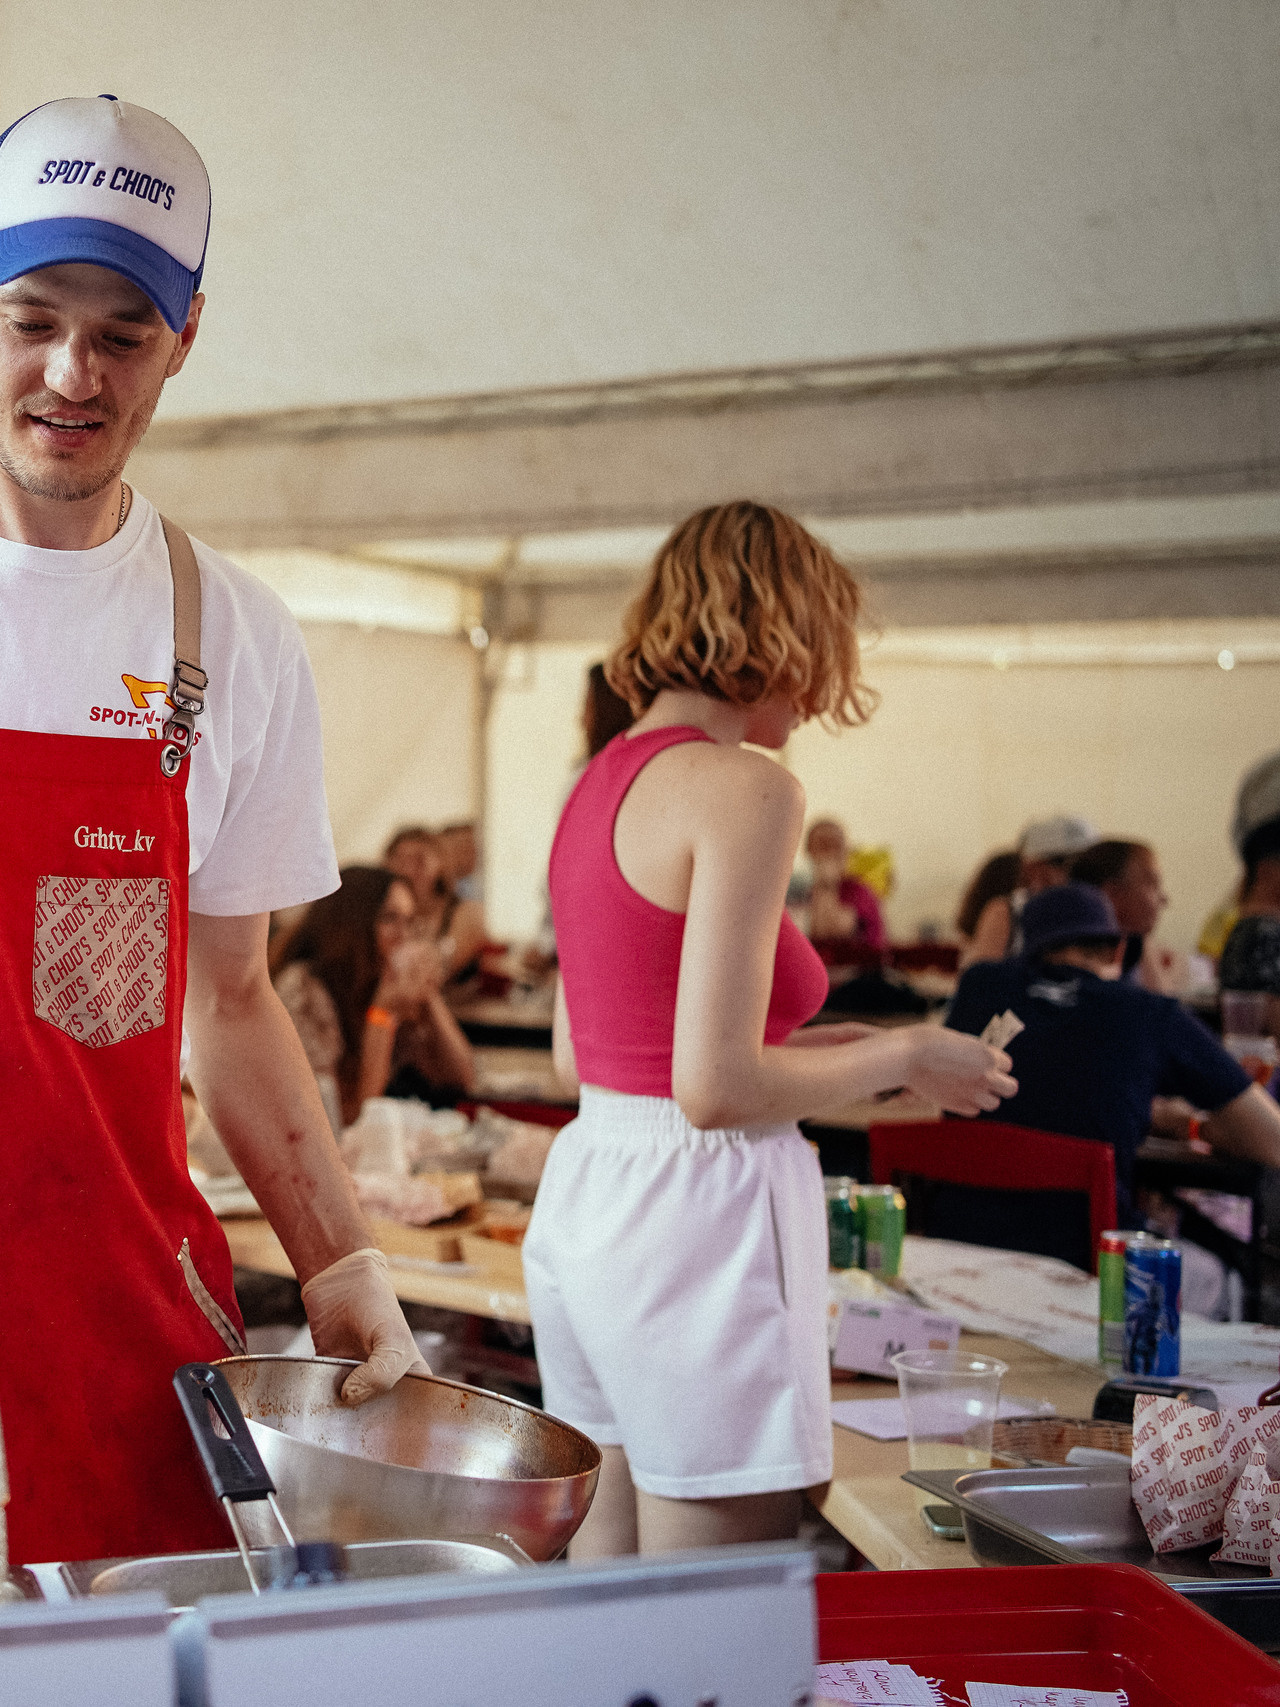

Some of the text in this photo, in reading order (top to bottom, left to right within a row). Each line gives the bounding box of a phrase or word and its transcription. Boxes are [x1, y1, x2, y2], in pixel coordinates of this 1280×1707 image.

[38, 160, 175, 211] SPOT & CHOO'S
[74, 825, 155, 852] Grhtv_kv
[47, 936, 92, 986] CHOO'S
[92, 902, 120, 942] SPOT
[50, 896, 95, 947] CHOO'S
[47, 975, 89, 1026] CHOO'S
[90, 940, 116, 981] SPOT
[121, 894, 156, 945] CHOO'S
[85, 981, 116, 1020] SPOT
[117, 932, 154, 984] CHOO'S
[116, 971, 154, 1023] CHOO'S
[1179, 1444, 1206, 1467] SPOT
[1177, 1498, 1218, 1524] CHOO'S
